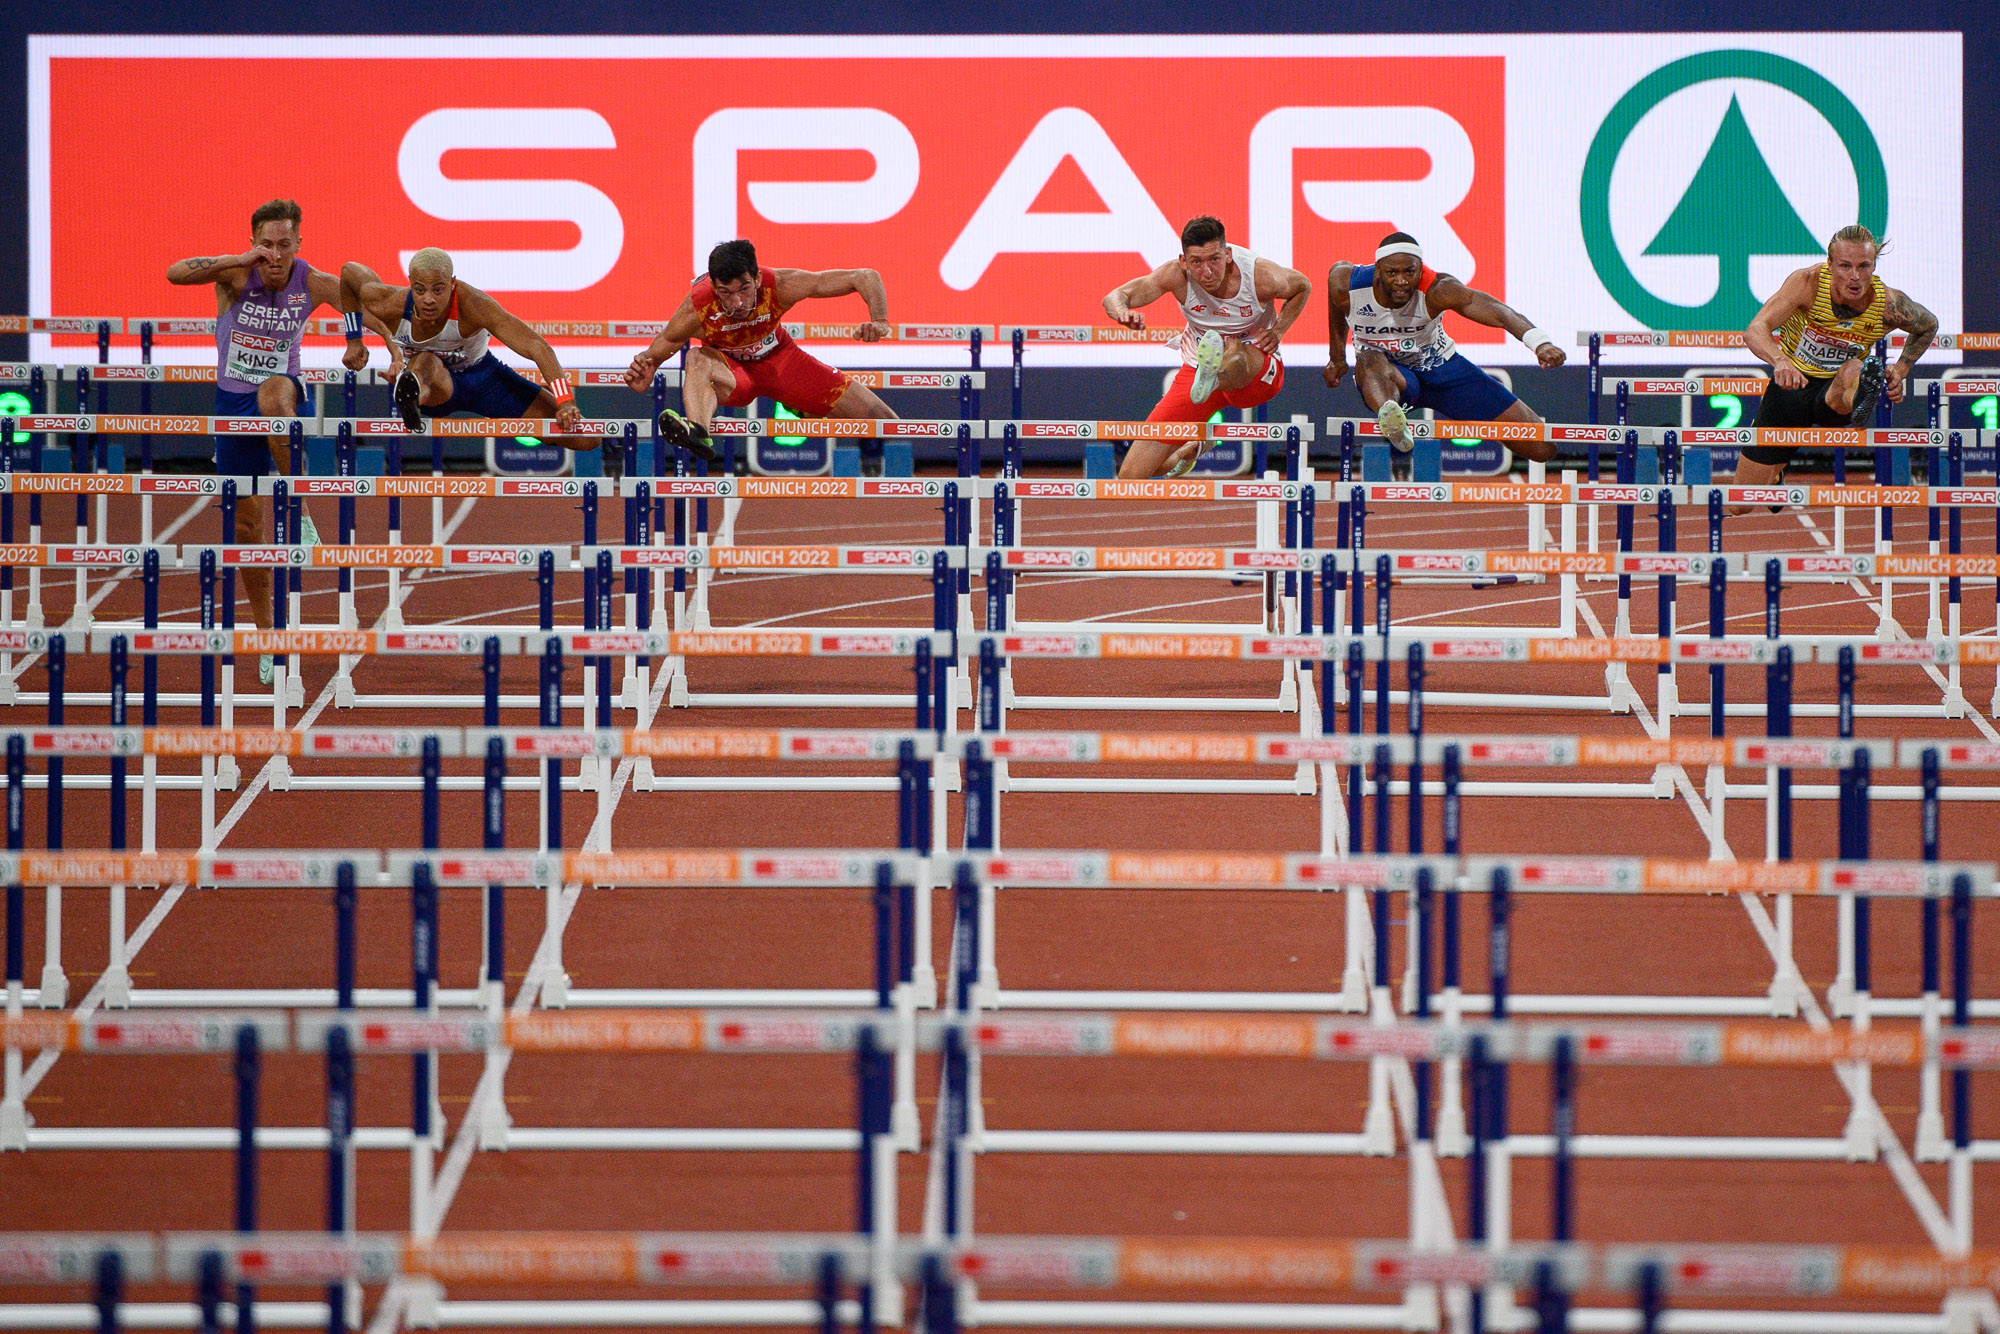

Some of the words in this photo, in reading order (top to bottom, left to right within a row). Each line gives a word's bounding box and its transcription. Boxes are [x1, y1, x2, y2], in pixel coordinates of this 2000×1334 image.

[398, 105, 1476, 292] SPAR
[241, 301, 302, 319] GREAT
[1356, 310, 1377, 318] adidas
[45, 320, 82, 330] SPAR
[170, 321, 206, 331] SPAR
[237, 312, 301, 332] BRITAIN
[531, 324, 569, 335] NICH
[573, 325, 602, 335] 2022
[627, 325, 664, 334] SPAR
[917, 328, 952, 337] SPAR
[1039, 330, 1075, 339] SPAR
[1354, 325, 1427, 334] FRANCE
[1809, 323, 1866, 342] GERMANY
[1099, 330, 1147, 341] MUNICH
[1616, 334, 1652, 344] SPAR
[1676, 334, 1725, 345] MUNICH
[1728, 335, 1744, 345] 20
[1805, 329, 1848, 349] SPAR
[233, 333, 276, 351] SPAR
[1368, 340, 1400, 352] PAR
[1964, 336, 2000, 347] MUNIC
[1803, 338, 1857, 360] TRABER
[237, 350, 278, 369] KING
[107, 368, 145, 377] SPAR
[172, 368, 218, 379] MUNIC
[228, 369, 259, 384] MUNICH
[598, 373, 627, 382] SPA
[902, 376, 941, 385] SPAR
[1647, 383, 1686, 392] SPAR
[1711, 381, 1762, 393] MUNICH
[1957, 383, 1996, 392] SPAR
[34, 419, 74, 428] SPAR
[104, 419, 160, 431] MUNICH
[165, 420, 199, 432] 2022
[228, 422, 270, 430] SPAR
[440, 421, 496, 433] MUNICH
[500, 422, 534, 434] 2022
[708, 424, 745, 432] SPAR
[774, 422, 830, 434] MUNICH
[835, 422, 869, 435] 2022
[896, 425, 938, 434] SPAR
[1036, 426, 1076, 434] SPAR
[1104, 424, 1160, 437] MUNICH
[1165, 425, 1199, 438] 2022
[1226, 427, 1268, 436] SPAR
[1502, 426, 1536, 439] 2022
[1566, 429, 1606, 438] SPAR
[1696, 432, 1736, 441] SPAR
[1764, 431, 1820, 443] MUNICH
[1825, 432, 1859, 444] 2022
[1888, 433, 1928, 442] SPAR
[20, 478, 82, 491] MUNICH
[86, 478, 123, 492] 2022
[155, 480, 198, 490] SPAR
[310, 482, 352, 492] SPAR
[385, 480, 446, 494] MUNICH
[451, 480, 488, 494] 2022
[518, 482, 560, 492] SPAR
[671, 483, 714, 493] SPAR
[746, 481, 808, 494] MUNICH
[812, 482, 849, 495] 2022
[879, 484, 922, 494] SPAR
[1030, 485, 1072, 495] SPAR
[1104, 483, 1166, 497] MUNICH
[1170, 484, 1208, 498] 2022
[1237, 486, 1280, 496] SPAR
[1386, 488, 1428, 498] SPAR
[1460, 487, 1521, 501] MUNICH
[1526, 488, 1562, 502] 2022
[1594, 490, 1636, 500] SPAR
[1744, 490, 1786, 500] SPAR
[1818, 490, 1880, 504] MUNICH
[1884, 491, 1921, 504] 2022
[1952, 492, 1994, 502] SPAR
[638, 528, 646, 545] MON
[0, 548, 38, 562] 2022
[72, 550, 120, 562] SPAR
[240, 551, 287, 562] SPAR
[322, 548, 388, 564] MUNICH
[393, 549, 434, 564] 2022
[468, 551, 515, 562] SPAR
[636, 552, 684, 562] SPAR
[718, 550, 784, 564] MUNICH
[789, 550, 830, 565] 2022
[862, 552, 910, 563] SPAR
[1023, 553, 1070, 564] SPAR
[1104, 551, 1170, 567] MUNICH
[1176, 552, 1216, 568] 2022
[1249, 554, 1296, 565] SPAR
[1414, 557, 1461, 568] SPAR
[1494, 556, 1560, 572] MUNICH
[1565, 556, 1606, 572] 2022
[1640, 560, 1687, 570] SPAR
[1804, 560, 1851, 571] SPAR
[1884, 558, 1950, 574] MUNICH
[1954, 559, 1996, 574] 2022
[151, 636, 206, 648] SPAR
[242, 633, 317, 651] MUNICH
[321, 633, 368, 652] 2022
[403, 636, 458, 648] SPAR
[588, 638, 643, 649] SPAR
[678, 634, 753, 653] MUNICH
[757, 634, 804, 654] 2022
[838, 638, 892, 650] SPAR
[1020, 640, 1075, 651] SPAR
[1108, 636, 1184, 656] MUNICH
[1188, 636, 1234, 657] 2022
[1268, 642, 1322, 653] SPAR
[1448, 644, 1502, 655] SPAR
[1536, 640, 1612, 660] MUNICH
[1616, 640, 1662, 661] 2022
[1696, 644, 1750, 656] SPAR
[1879, 646, 1934, 658] SPAR
